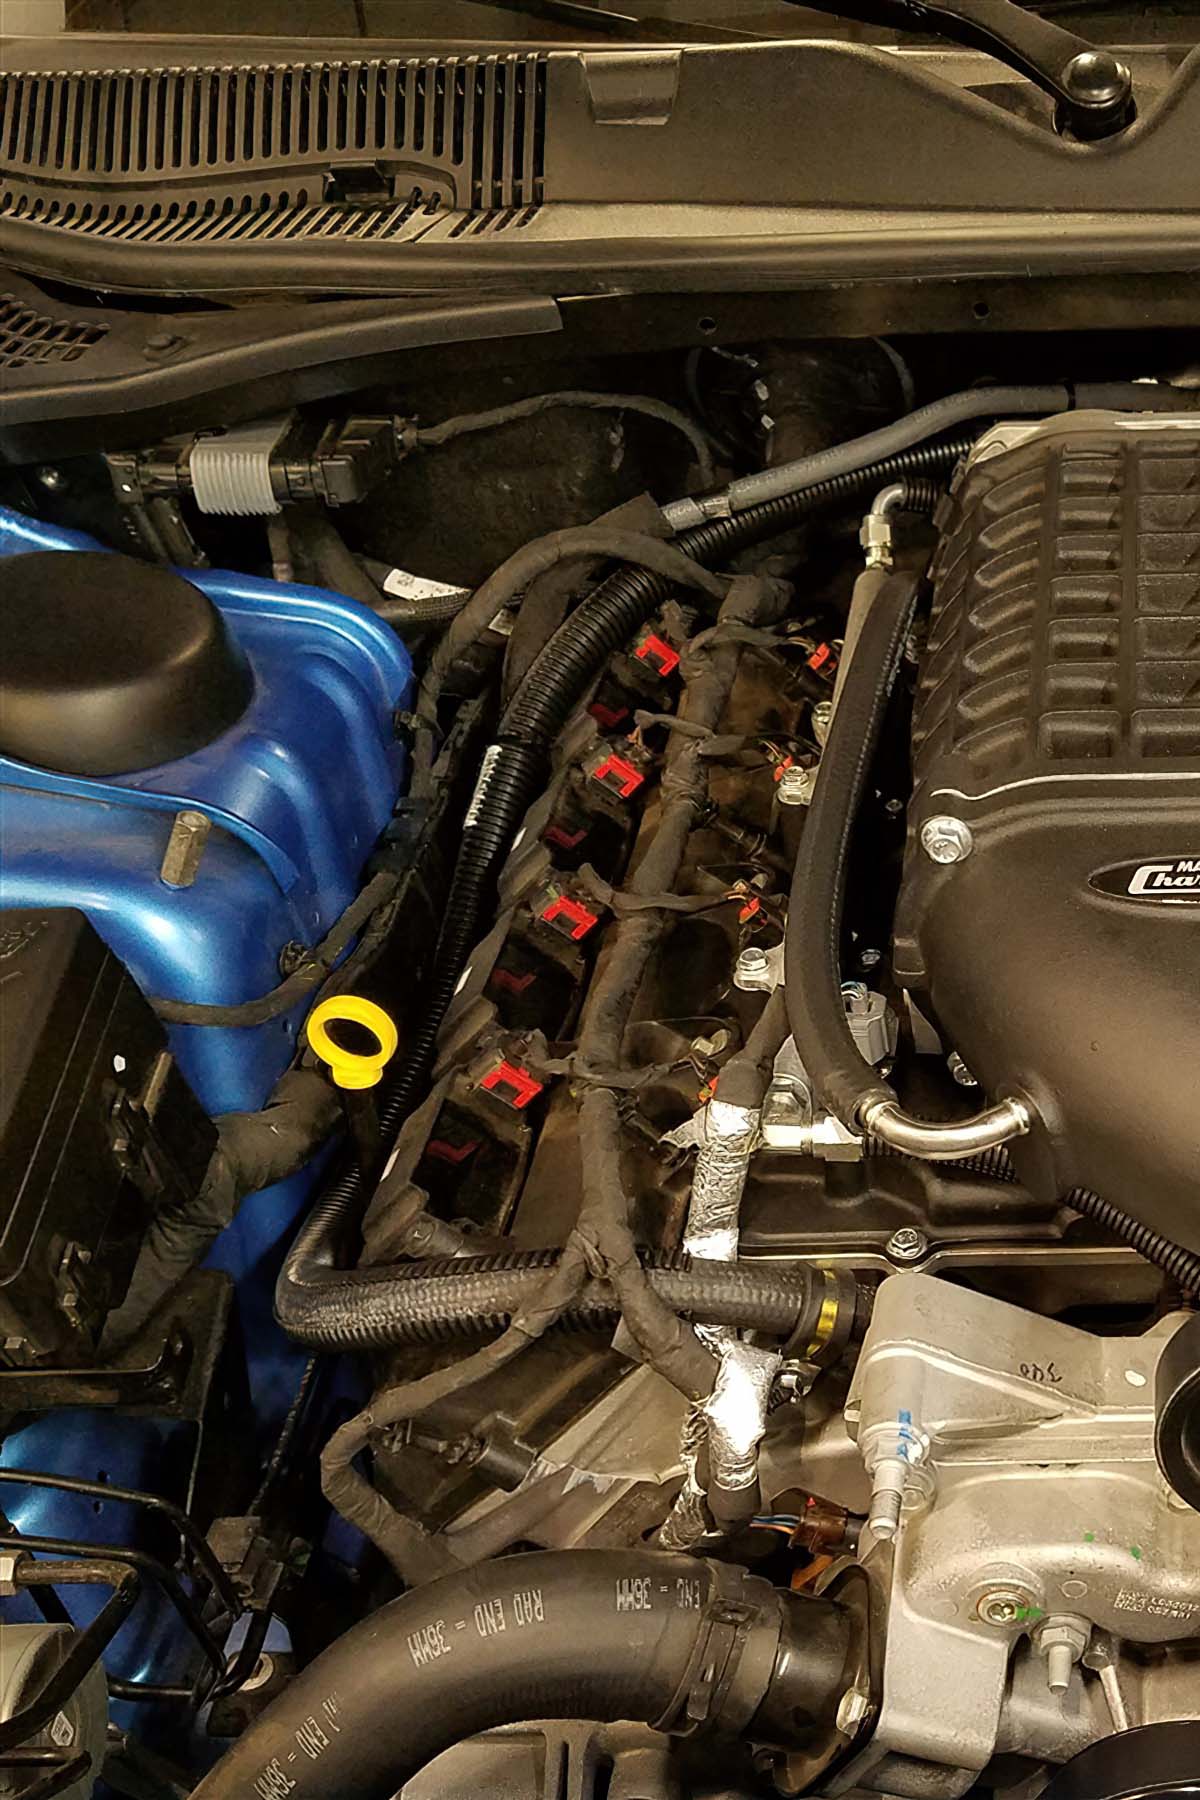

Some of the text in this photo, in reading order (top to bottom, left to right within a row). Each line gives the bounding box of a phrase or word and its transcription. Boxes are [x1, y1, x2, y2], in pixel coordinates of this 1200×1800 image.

[513, 1589, 545, 1627] RAD
[616, 1577, 652, 1611] 36MM
[474, 1598, 506, 1638] END
[406, 1619, 452, 1668] 36MM
[295, 1716, 330, 1760] END
